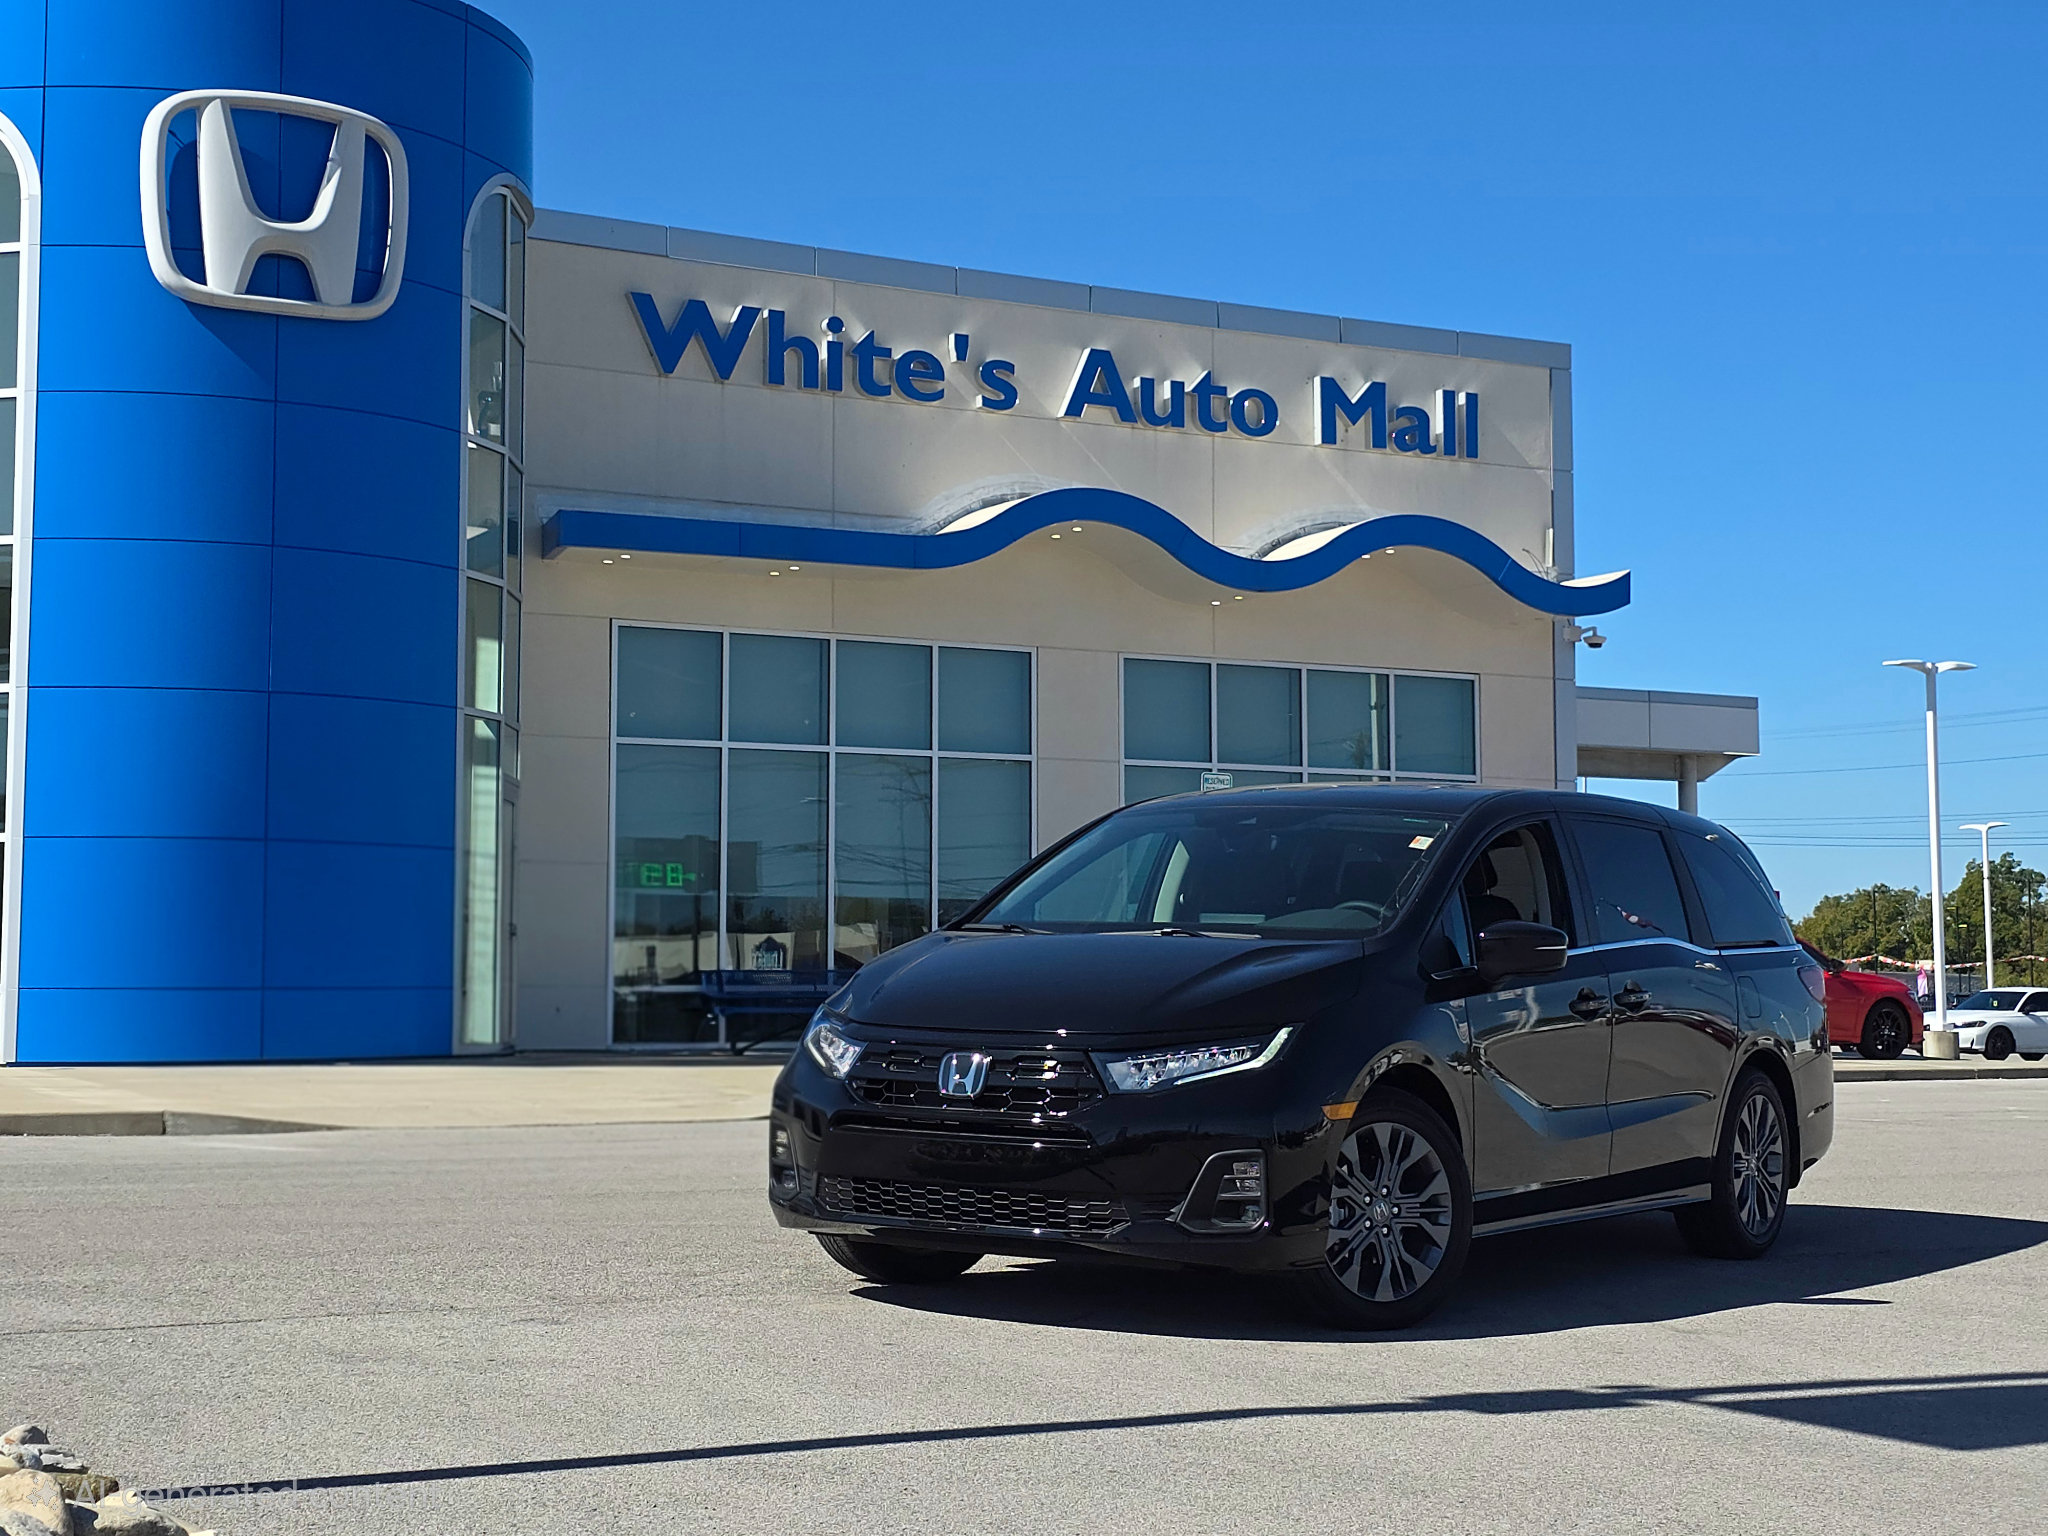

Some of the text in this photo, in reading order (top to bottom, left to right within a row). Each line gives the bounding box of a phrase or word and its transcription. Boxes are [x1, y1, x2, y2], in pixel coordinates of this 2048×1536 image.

[630, 291, 1479, 459] White's Auto Mall
